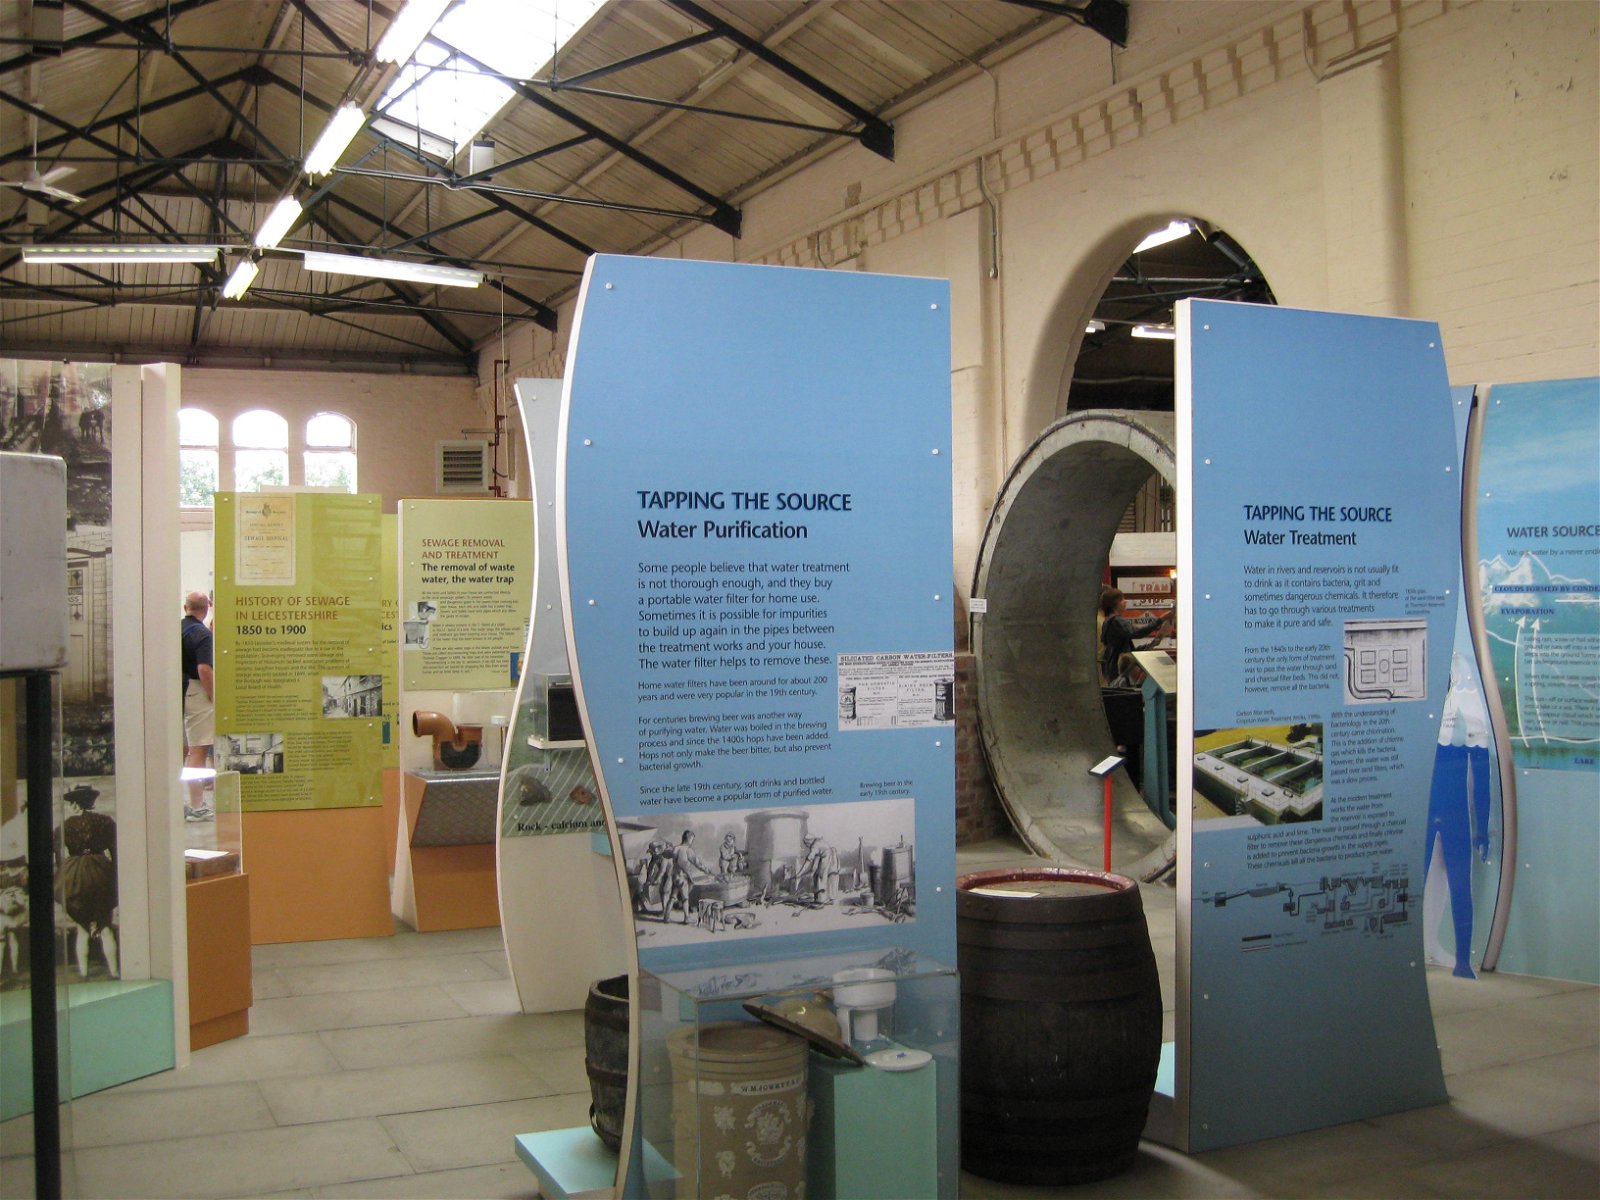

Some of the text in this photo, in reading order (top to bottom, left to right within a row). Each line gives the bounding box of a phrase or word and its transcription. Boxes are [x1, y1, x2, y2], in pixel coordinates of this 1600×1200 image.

[637, 491, 852, 509] TAPPING THE SOURCE
[1244, 505, 1392, 520] TAPPING THE SOURCE
[638, 520, 807, 537] Water Purification
[1507, 526, 1548, 538] WATER
[422, 538, 505, 547] SEWAGE REMOVAL
[1244, 530, 1356, 544] Water Treatment
[422, 551, 499, 559] AND TREATMENT
[422, 563, 438, 571] The
[441, 563, 476, 571] removal
[479, 563, 488, 571] of
[639, 562, 849, 575] Some people believe that water treatment
[1244, 566, 1266, 574] Water
[1268, 565, 1275, 574] in
[1277, 566, 1295, 574] rivers
[1298, 565, 1311, 574] and
[1313, 565, 1345, 574] reservoirs
[1368, 565, 1390, 576] usually
[422, 576, 448, 584] water,
[496, 576, 514, 585] trap
[639, 578, 832, 592] is not thorough enough, and they buy
[1254, 579, 1273, 588] drink
[1323, 578, 1351, 588] bacteria,
[1354, 579, 1366, 589] grit
[1368, 578, 1380, 587] and
[236, 596, 350, 606] HISTORY OF SEWAGE
[648, 594, 691, 607] portable
[694, 595, 723, 604] water
[726, 593, 748, 604] filter
[752, 593, 765, 603] for
[769, 593, 797, 603] home
[1244, 591, 1398, 603] sometimes dangerous chemicals. It therefore
[236, 611, 338, 620] IN LEICESTERSHIRE
[639, 608, 827, 622] Sometimes it is possible for impurities
[1245, 604, 1375, 617] has to go through various treatments
[1255, 619, 1274, 628] make
[1277, 619, 1281, 628] it
[1284, 620, 1300, 629] pure
[1302, 619, 1316, 627] and
[1318, 618, 1333, 627] safe.
[236, 625, 306, 635] 1850 to 1900
[639, 623, 834, 639] to build up again in the pipes between
[639, 639, 825, 653] the treatment works and your house.
[639, 654, 832, 670] The water filter helps to remove these.
[750, 678, 776, 686] around
[814, 676, 827, 684] 200
[638, 695, 657, 703] years
[660, 692, 674, 700] and
[716, 690, 744, 700] popular
[789, 689, 817, 697] century.
[518, 822, 541, 831] Rock
[551, 820, 587, 829] calcium
